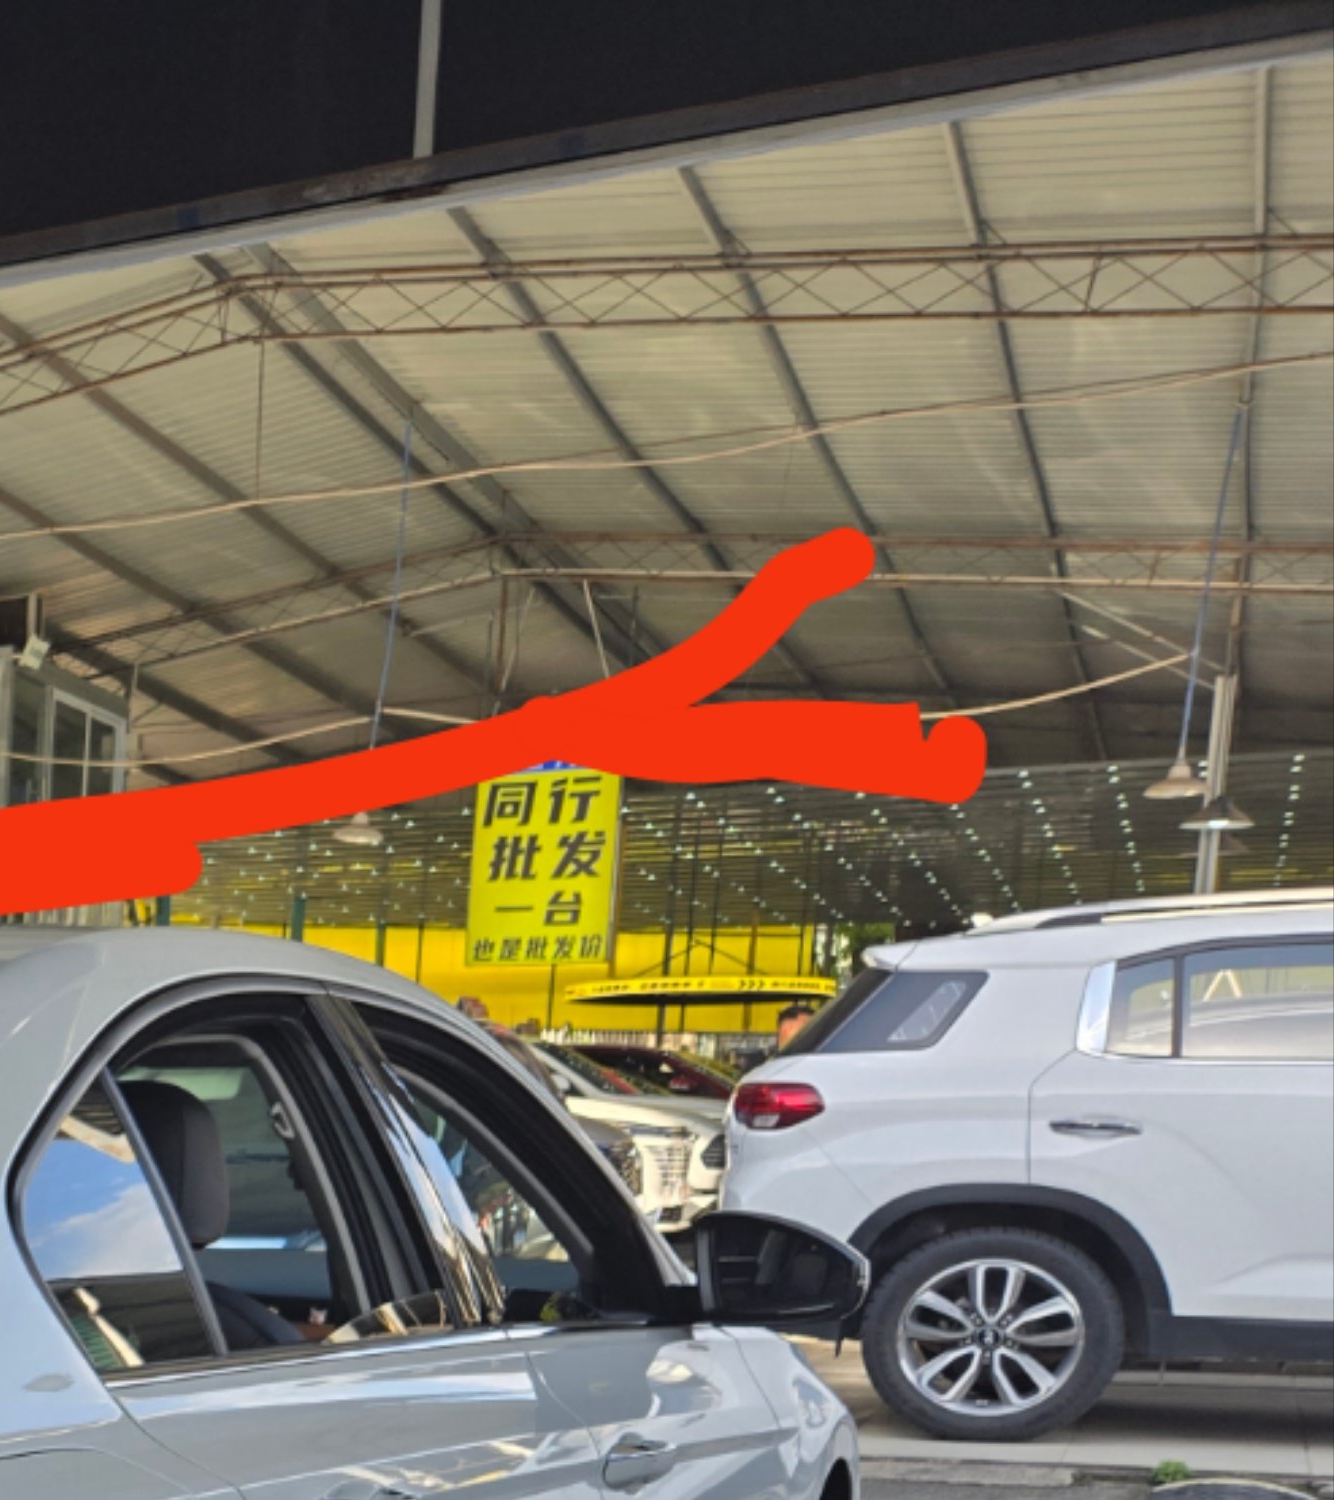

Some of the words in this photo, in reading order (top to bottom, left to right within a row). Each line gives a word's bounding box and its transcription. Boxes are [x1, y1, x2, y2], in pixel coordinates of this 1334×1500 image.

[482, 775, 603, 827] 同行
[487, 831, 607, 881] 批发
[494, 890, 583, 926] 一台
[472, 934, 603, 962] 也是批发价
